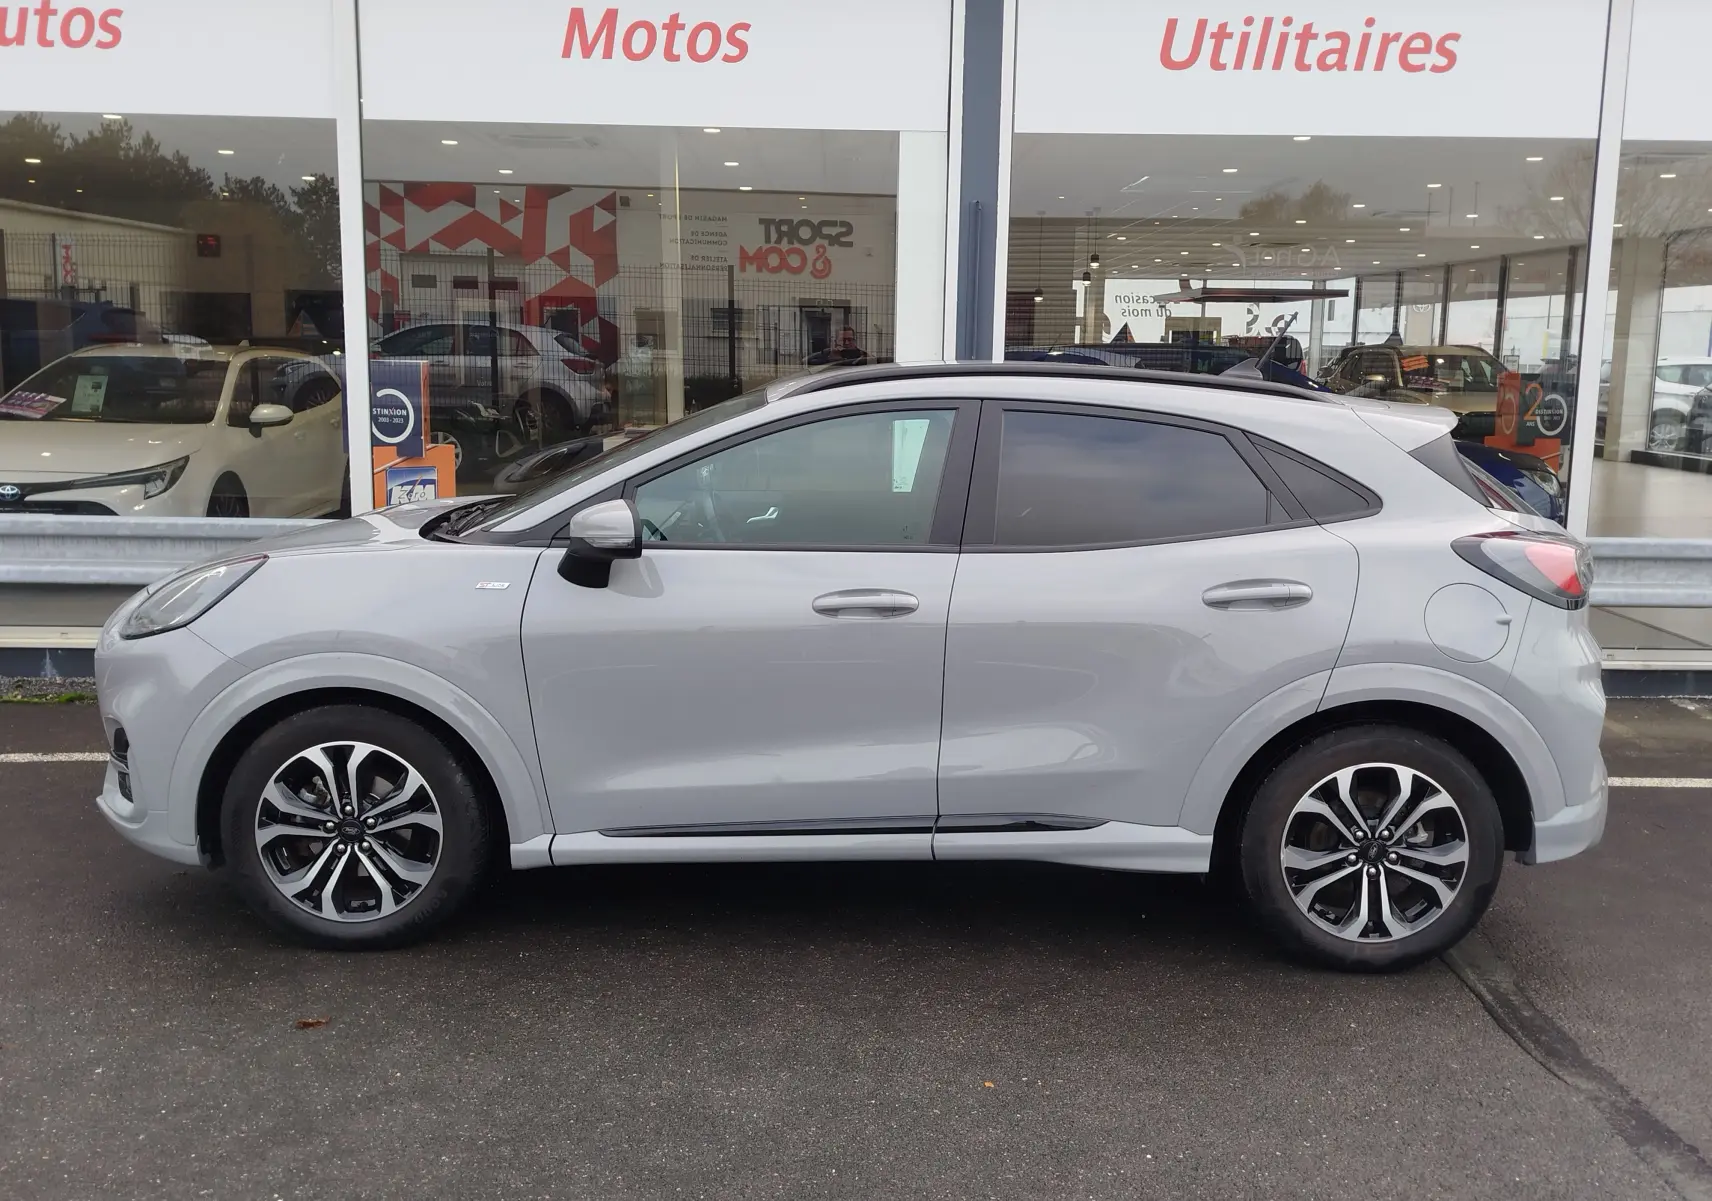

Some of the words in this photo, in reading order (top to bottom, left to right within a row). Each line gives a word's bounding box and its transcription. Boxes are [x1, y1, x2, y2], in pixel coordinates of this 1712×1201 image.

[561, 7, 752, 63] Motos
[1160, 16, 1462, 73] Utilitaires
[398, 489, 426, 499] Zero
